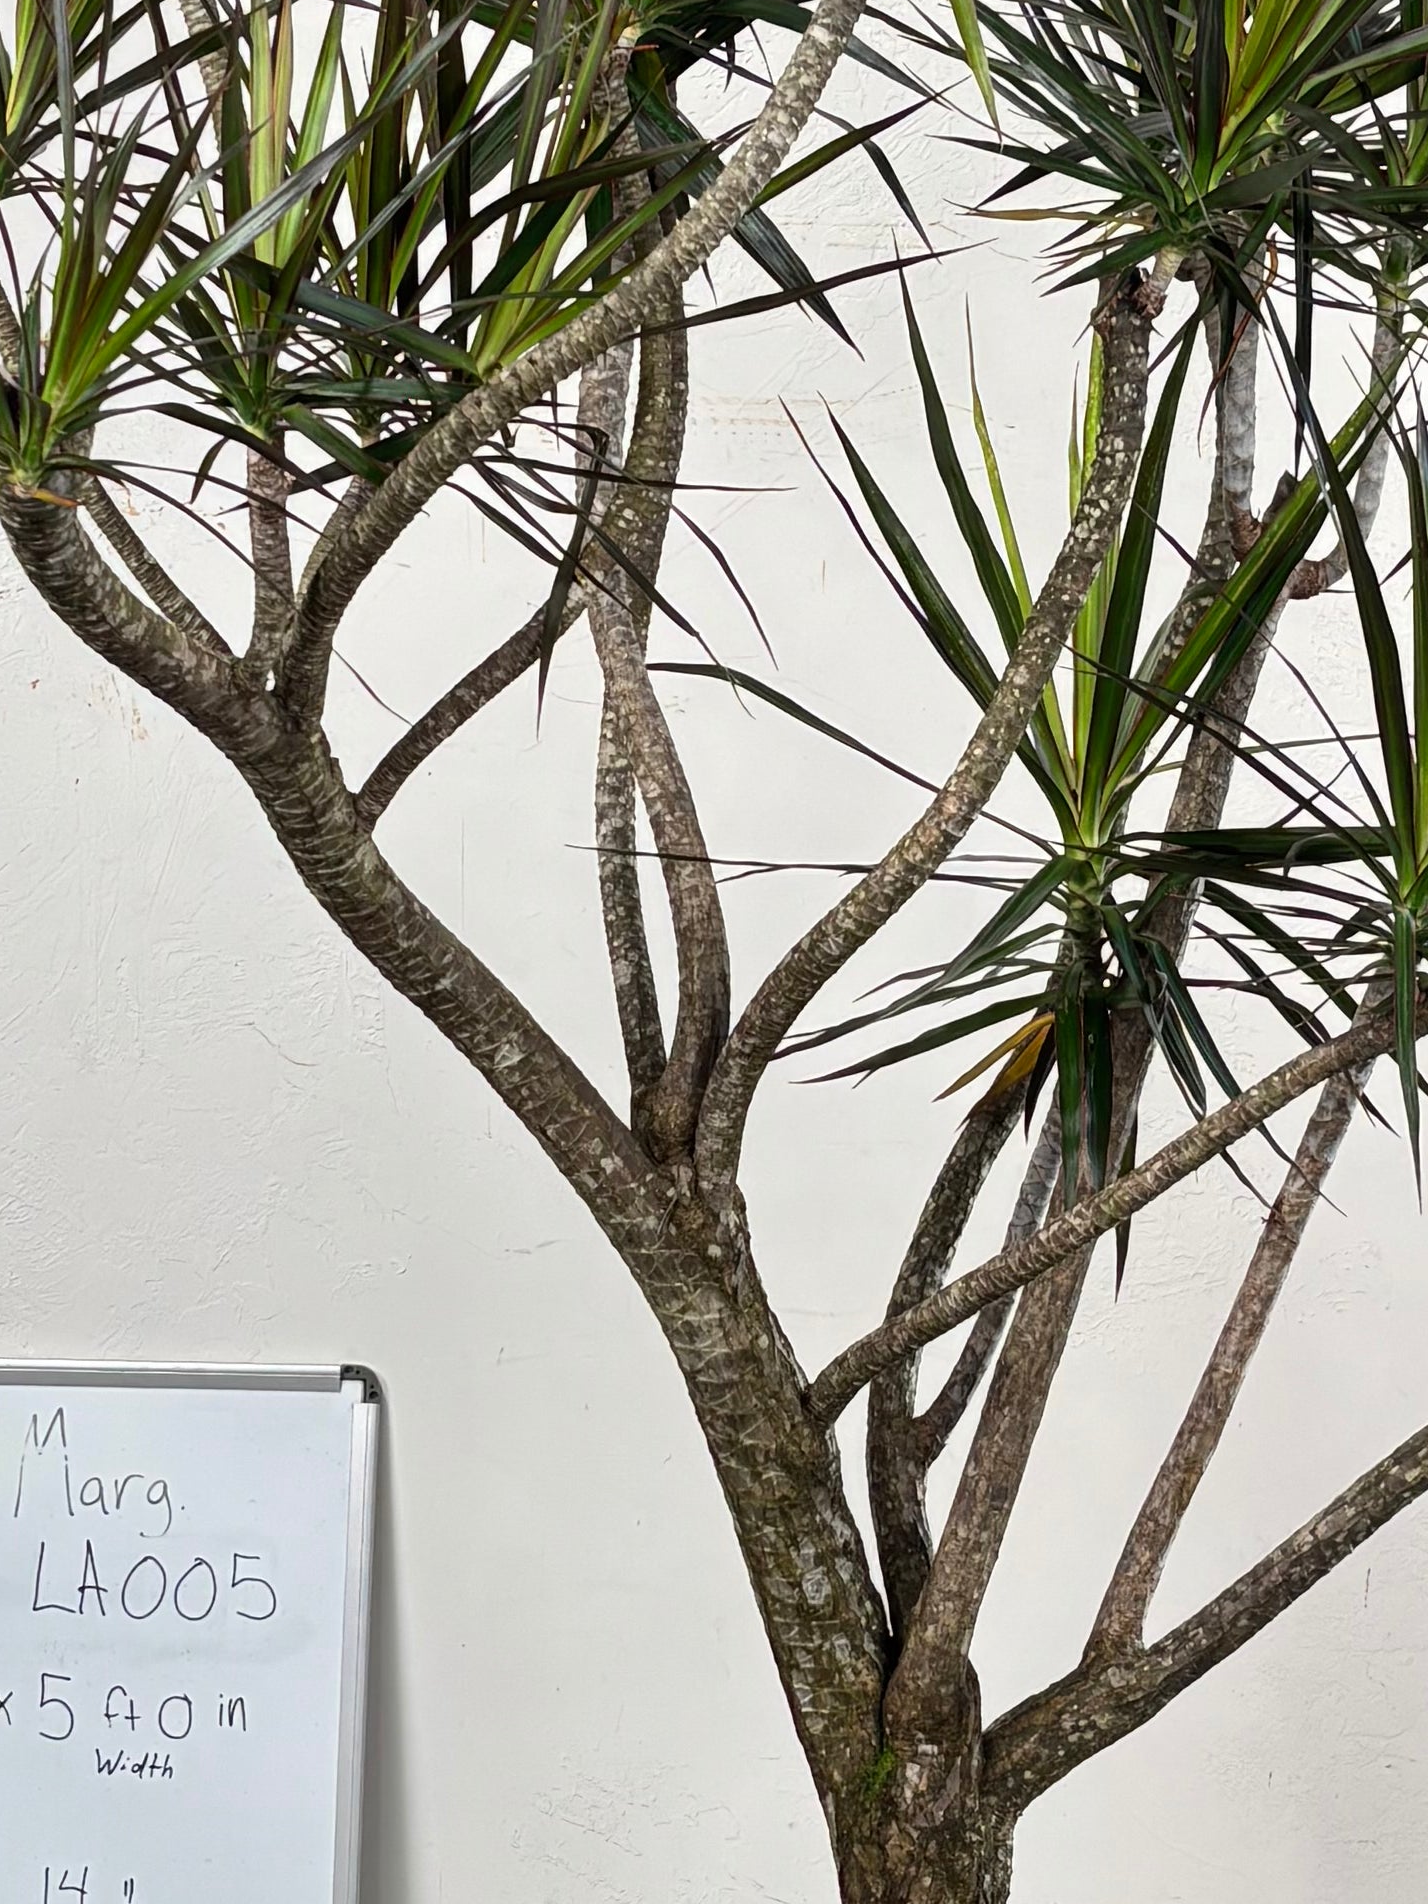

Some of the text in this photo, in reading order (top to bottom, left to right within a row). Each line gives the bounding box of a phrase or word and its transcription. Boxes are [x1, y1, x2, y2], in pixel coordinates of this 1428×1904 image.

[31, 1539, 278, 1620] LA005
[38, 1672, 74, 1741] 5
[218, 1693, 247, 1732] in
[94, 1747, 174, 1780] Width
